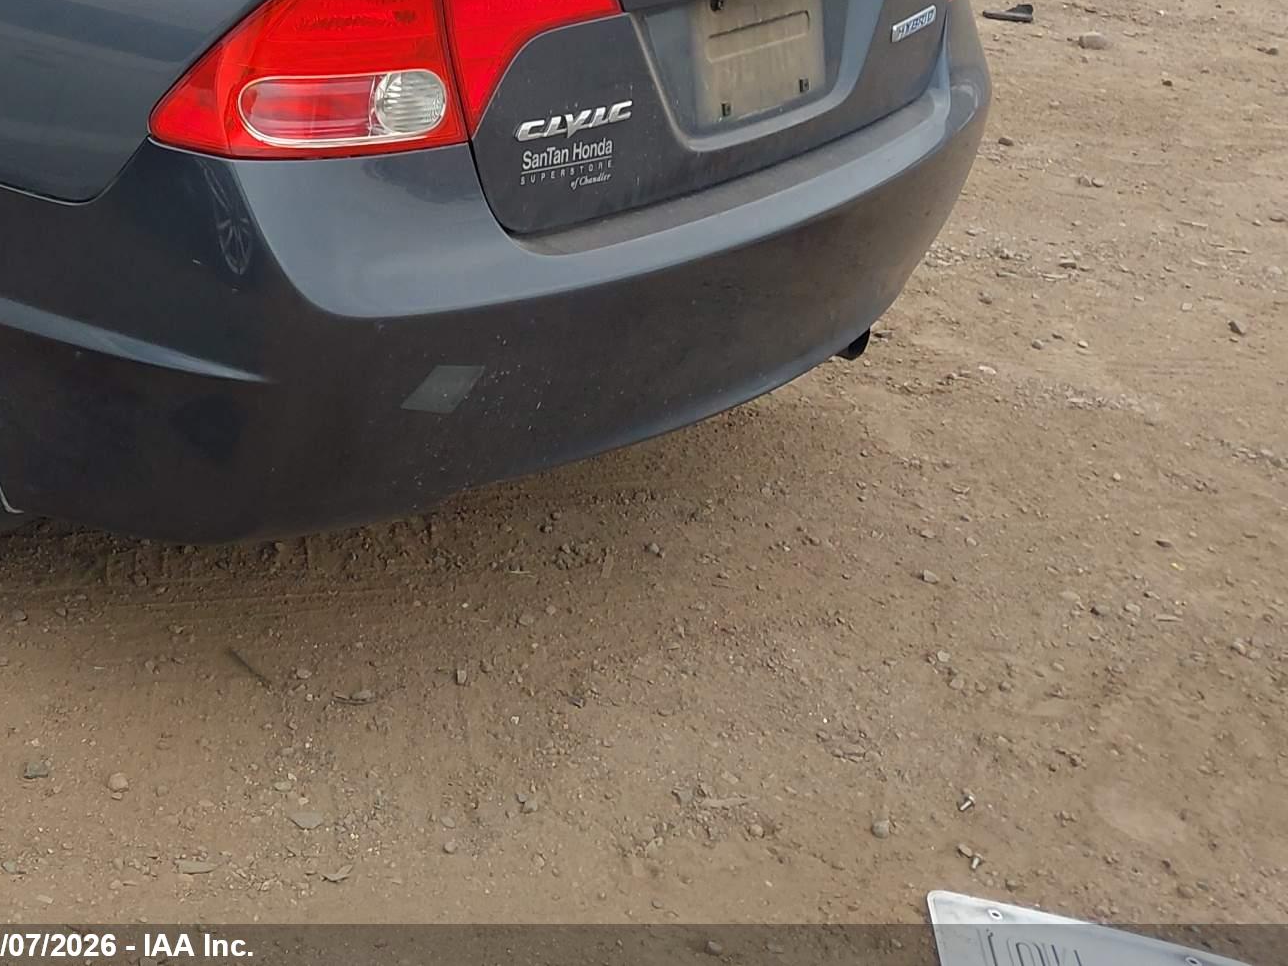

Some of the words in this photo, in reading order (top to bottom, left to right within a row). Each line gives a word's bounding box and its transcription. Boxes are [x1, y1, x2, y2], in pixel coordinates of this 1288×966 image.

[516, 100, 632, 142] CIVIC
[522, 146, 569, 170] SanTan
[573, 137, 613, 161] Honda
[520, 159, 612, 185] SUPERSTORE
[579, 172, 612, 187] Chandler
